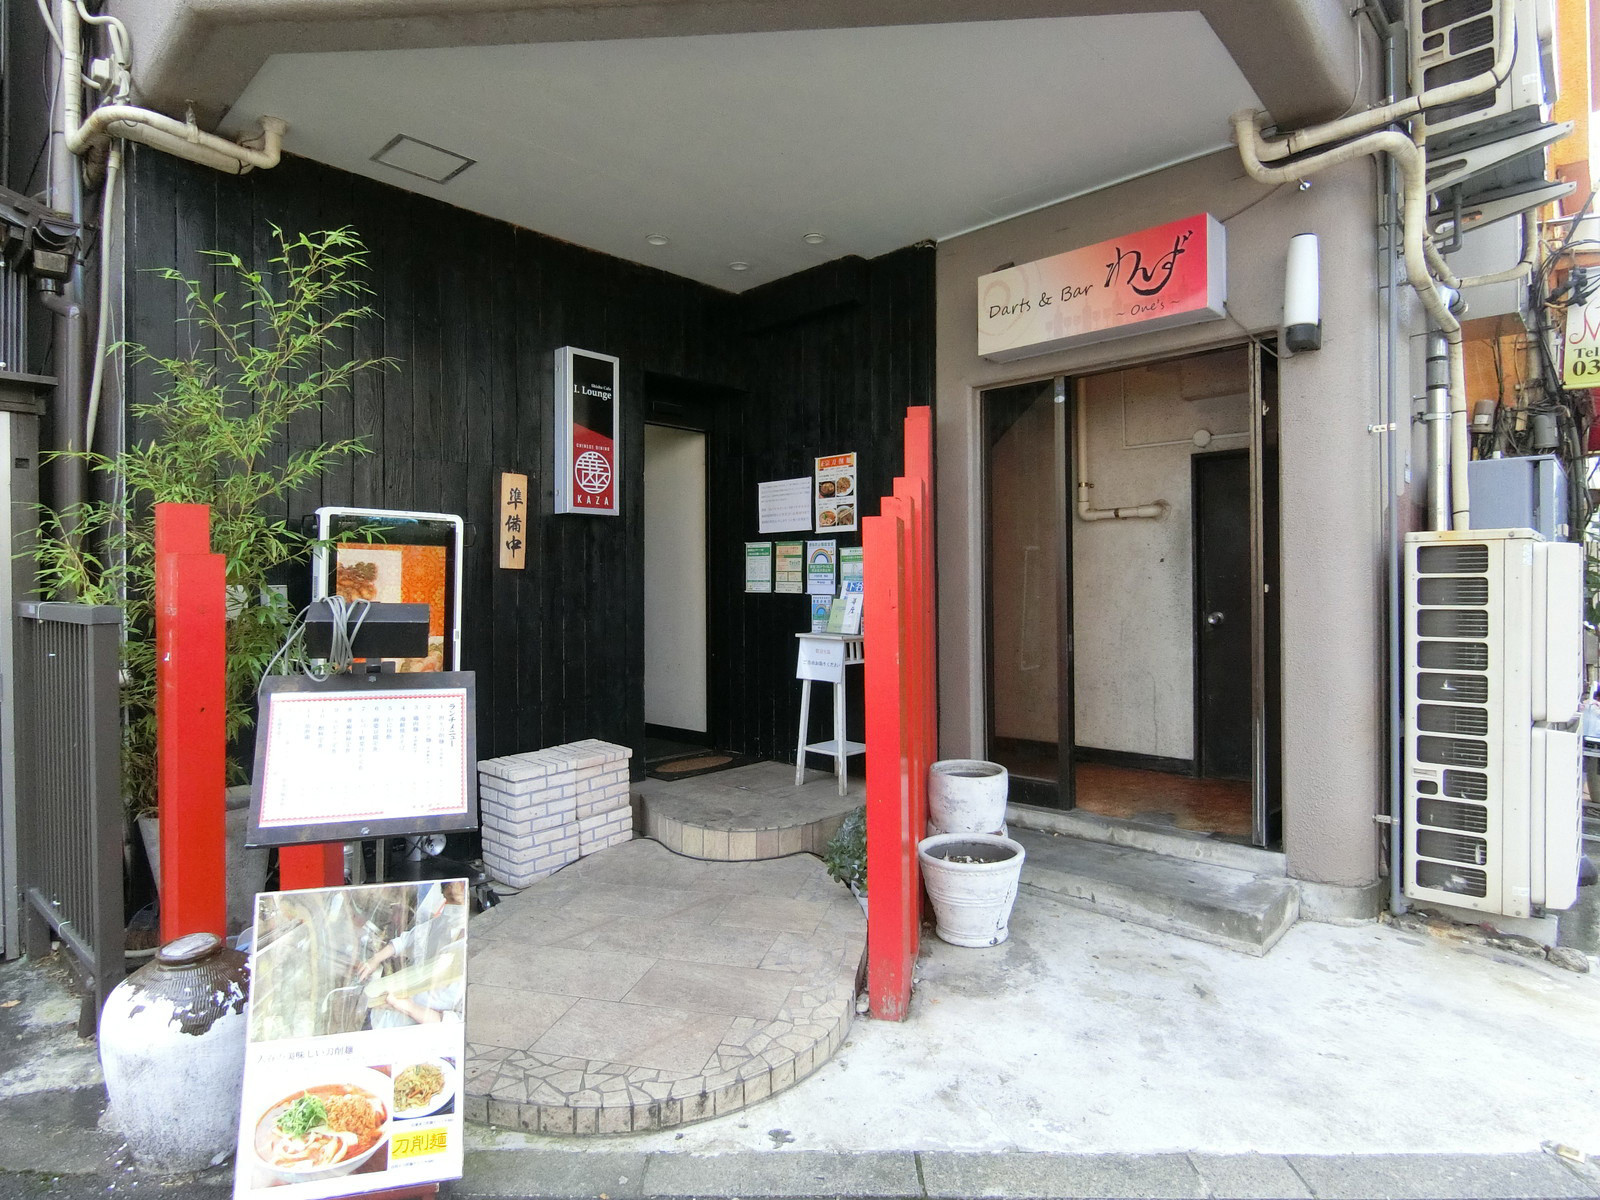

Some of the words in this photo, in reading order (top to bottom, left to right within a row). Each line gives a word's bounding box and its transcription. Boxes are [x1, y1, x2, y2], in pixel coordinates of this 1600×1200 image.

[989, 298, 1031, 319] Darts
[1038, 292, 1052, 307] &
[1061, 283, 1094, 302] Bar
[1572, 359, 1600, 376] 03
[582, 385, 612, 401] Lounge
[577, 495, 609, 506] KAZA
[505, 487, 524, 559] 準備中
[448, 703, 457, 747] ランチメニュー
[392, 1132, 448, 1154] 刀削麺
